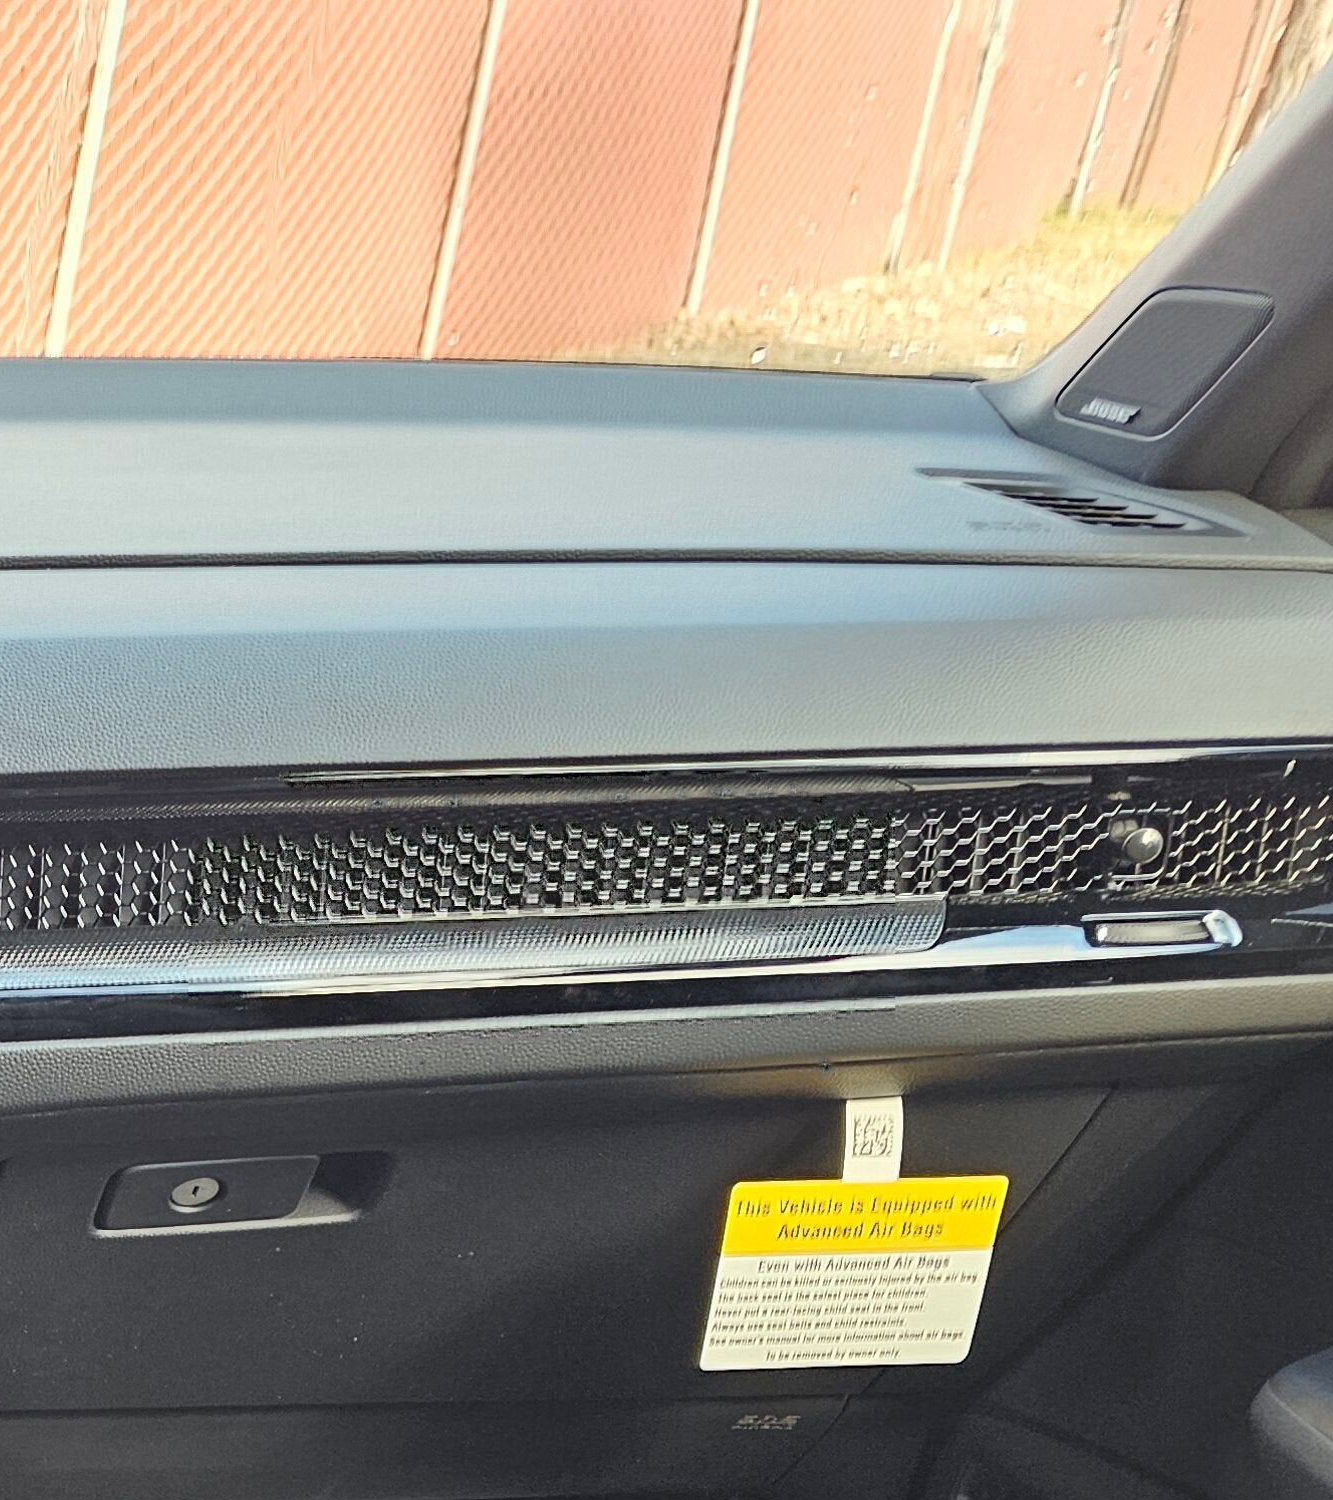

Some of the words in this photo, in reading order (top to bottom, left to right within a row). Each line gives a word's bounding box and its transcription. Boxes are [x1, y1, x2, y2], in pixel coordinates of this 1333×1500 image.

[737, 1199, 770, 1216] This
[780, 1198, 842, 1215] Vehicle
[850, 1197, 863, 1213] is
[871, 1195, 954, 1215] Equipped
[961, 1193, 996, 1210] with
[777, 1223, 864, 1240] Advanced
[869, 1221, 893, 1238] Air
[901, 1221, 944, 1239] Bags
[757, 1259, 789, 1274] Even
[795, 1258, 821, 1273] with
[825, 1256, 890, 1272] Advanced
[894, 1256, 912, 1270] Air
[917, 1255, 950, 1271] Bags
